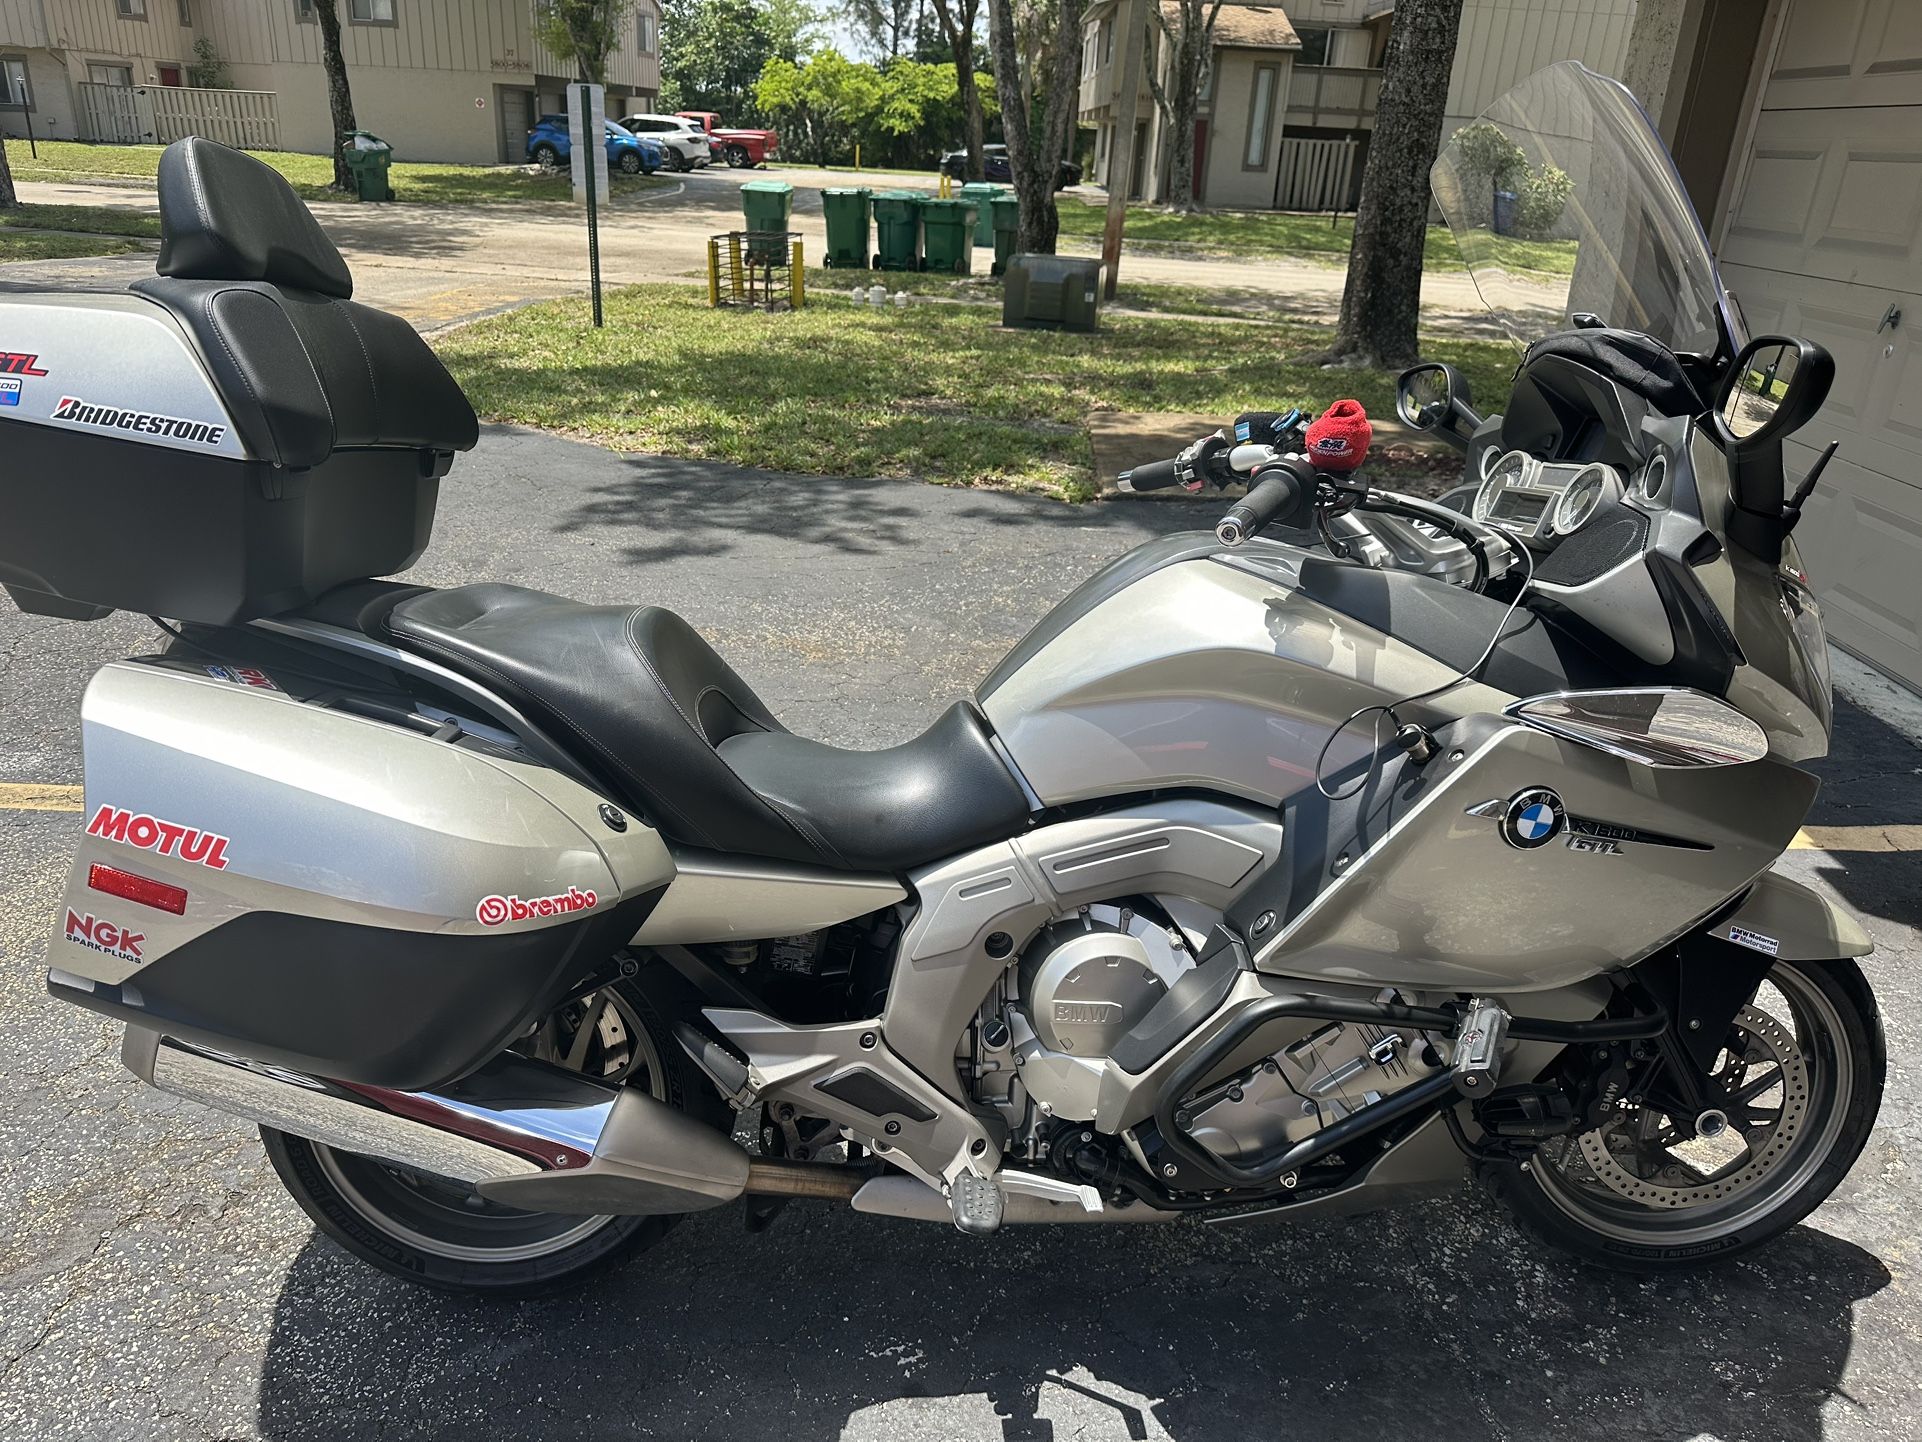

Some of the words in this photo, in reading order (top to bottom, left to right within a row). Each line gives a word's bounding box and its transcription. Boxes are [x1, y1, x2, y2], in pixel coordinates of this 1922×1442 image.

[0, 351, 49, 377] TL
[0, 382, 18, 390] 00
[53, 397, 226, 445] BRIDGESTONE
[1520, 793, 1563, 816] BMW
[86, 805, 230, 870] MOTUL
[509, 888, 598, 921] brembo
[65, 908, 146, 958] NGK
[1731, 926, 1750, 938] BMW
[1749, 932, 1778, 947] Motorrad
[1740, 935, 1777, 953] Motorsport
[65, 933, 102, 953] SPARK
[103, 946, 142, 965] PLUGS
[1055, 1005, 1110, 1023] BMW
[1599, 1081, 1620, 1113] BMW
[326, 1203, 403, 1260] MICHELIN
[1668, 1241, 1721, 1258] MICHELIN
